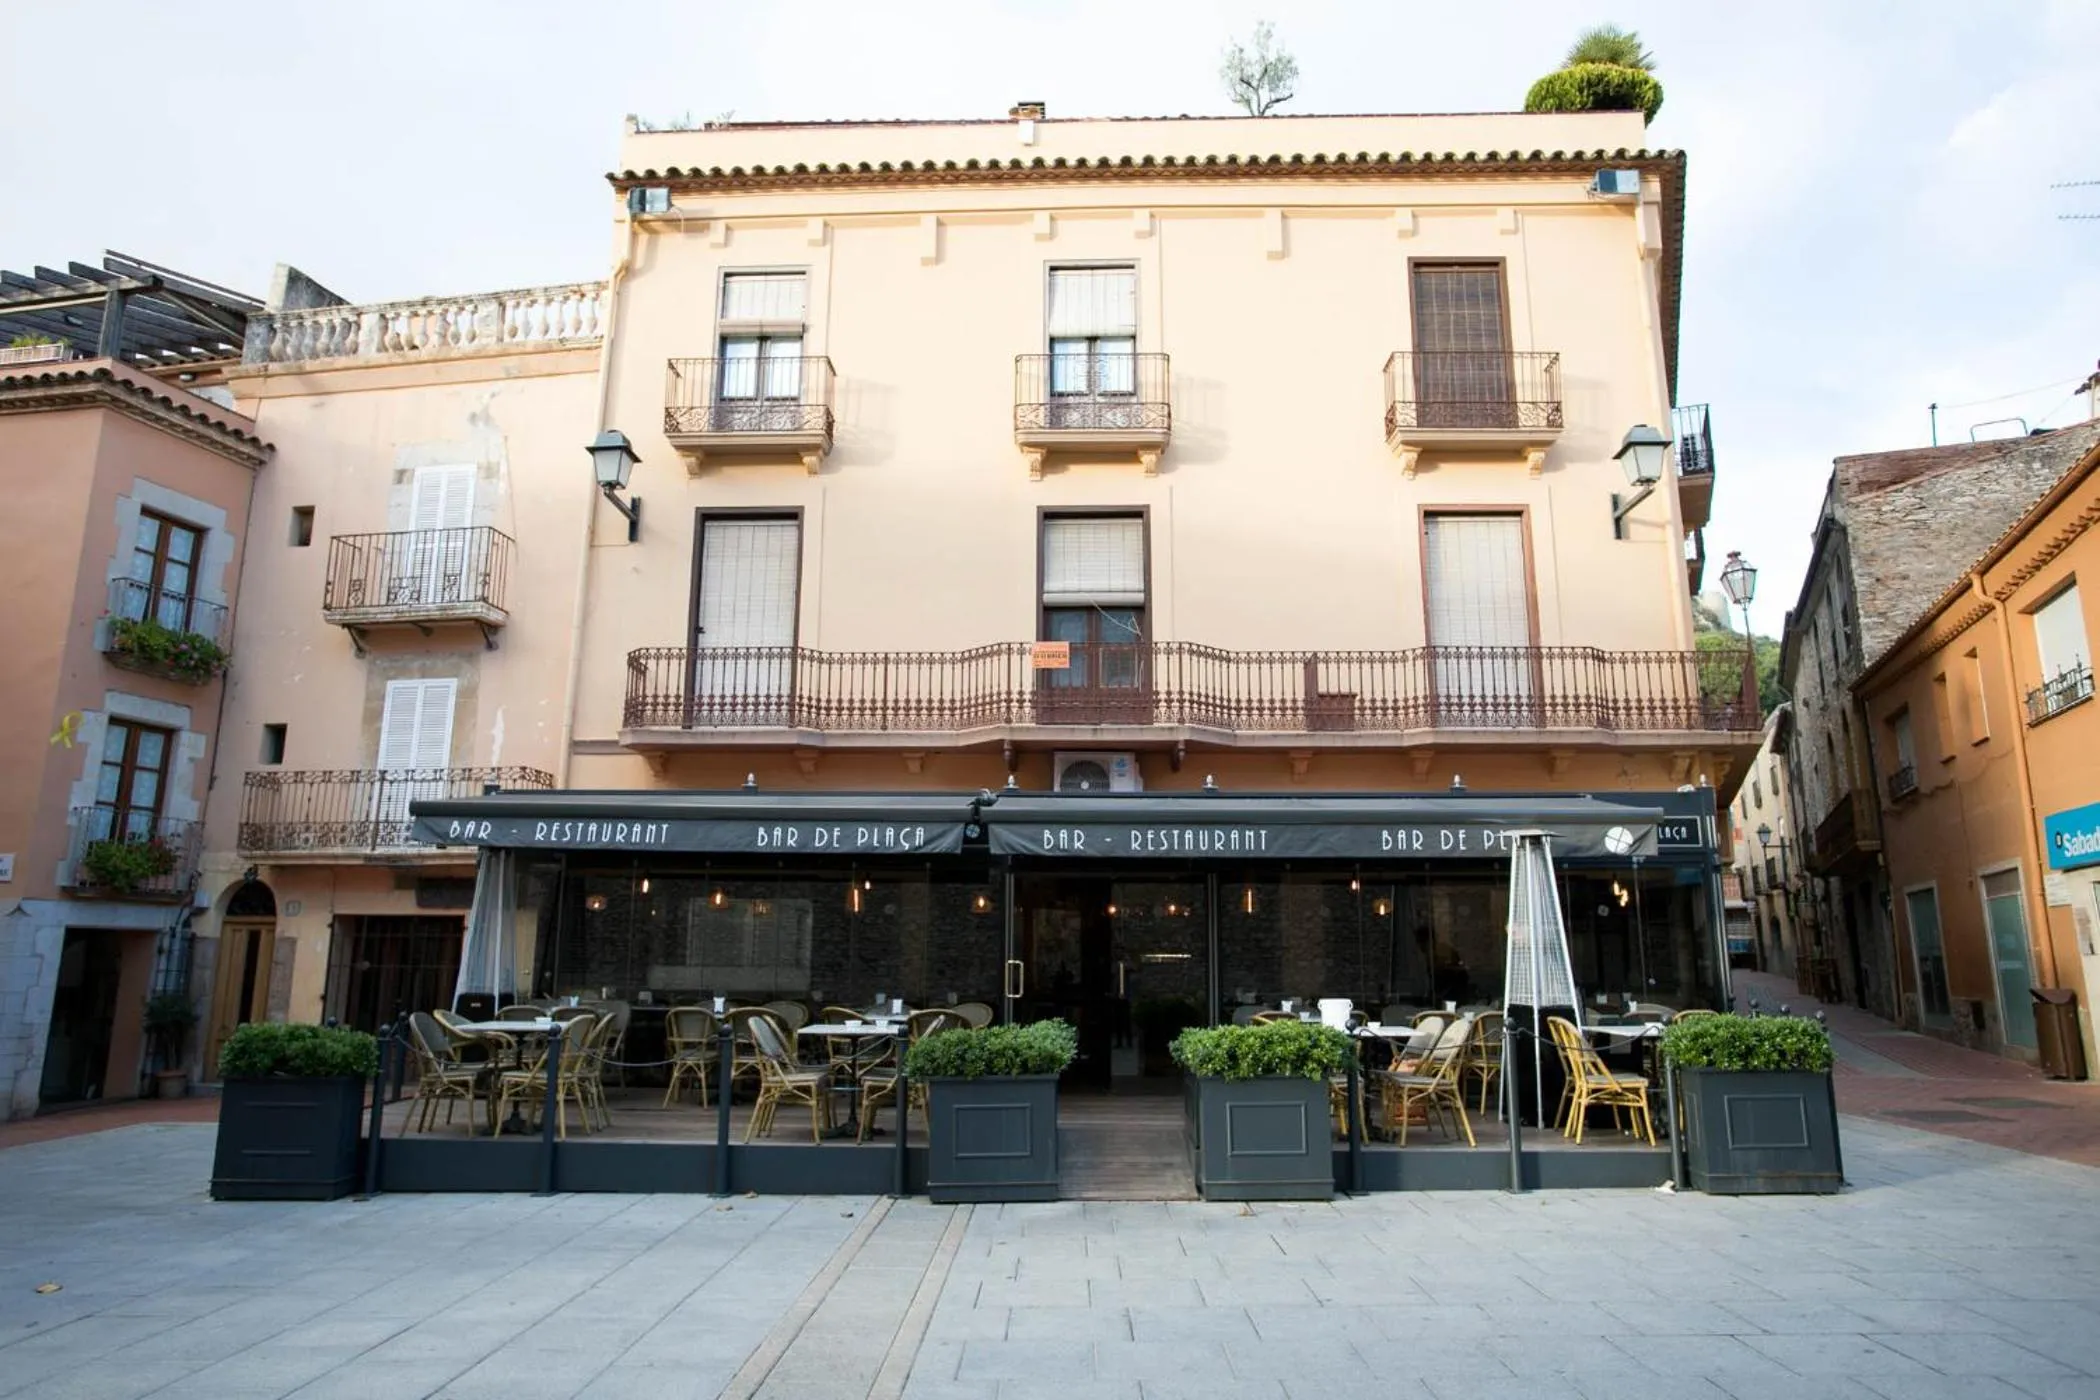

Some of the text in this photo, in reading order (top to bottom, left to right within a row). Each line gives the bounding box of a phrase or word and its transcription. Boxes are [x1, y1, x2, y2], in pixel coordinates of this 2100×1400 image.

[449, 820, 492, 840] BAR
[535, 821, 669, 844] RESTAURANT
[757, 826, 925, 851] BAR DE PLAÇA
[1043, 829, 1085, 850] BAR
[1131, 829, 1268, 851] RESTAURANT
[1382, 829, 1423, 851] BAR
[1440, 829, 1467, 851] DE
[1658, 826, 1687, 841] LAÇA
